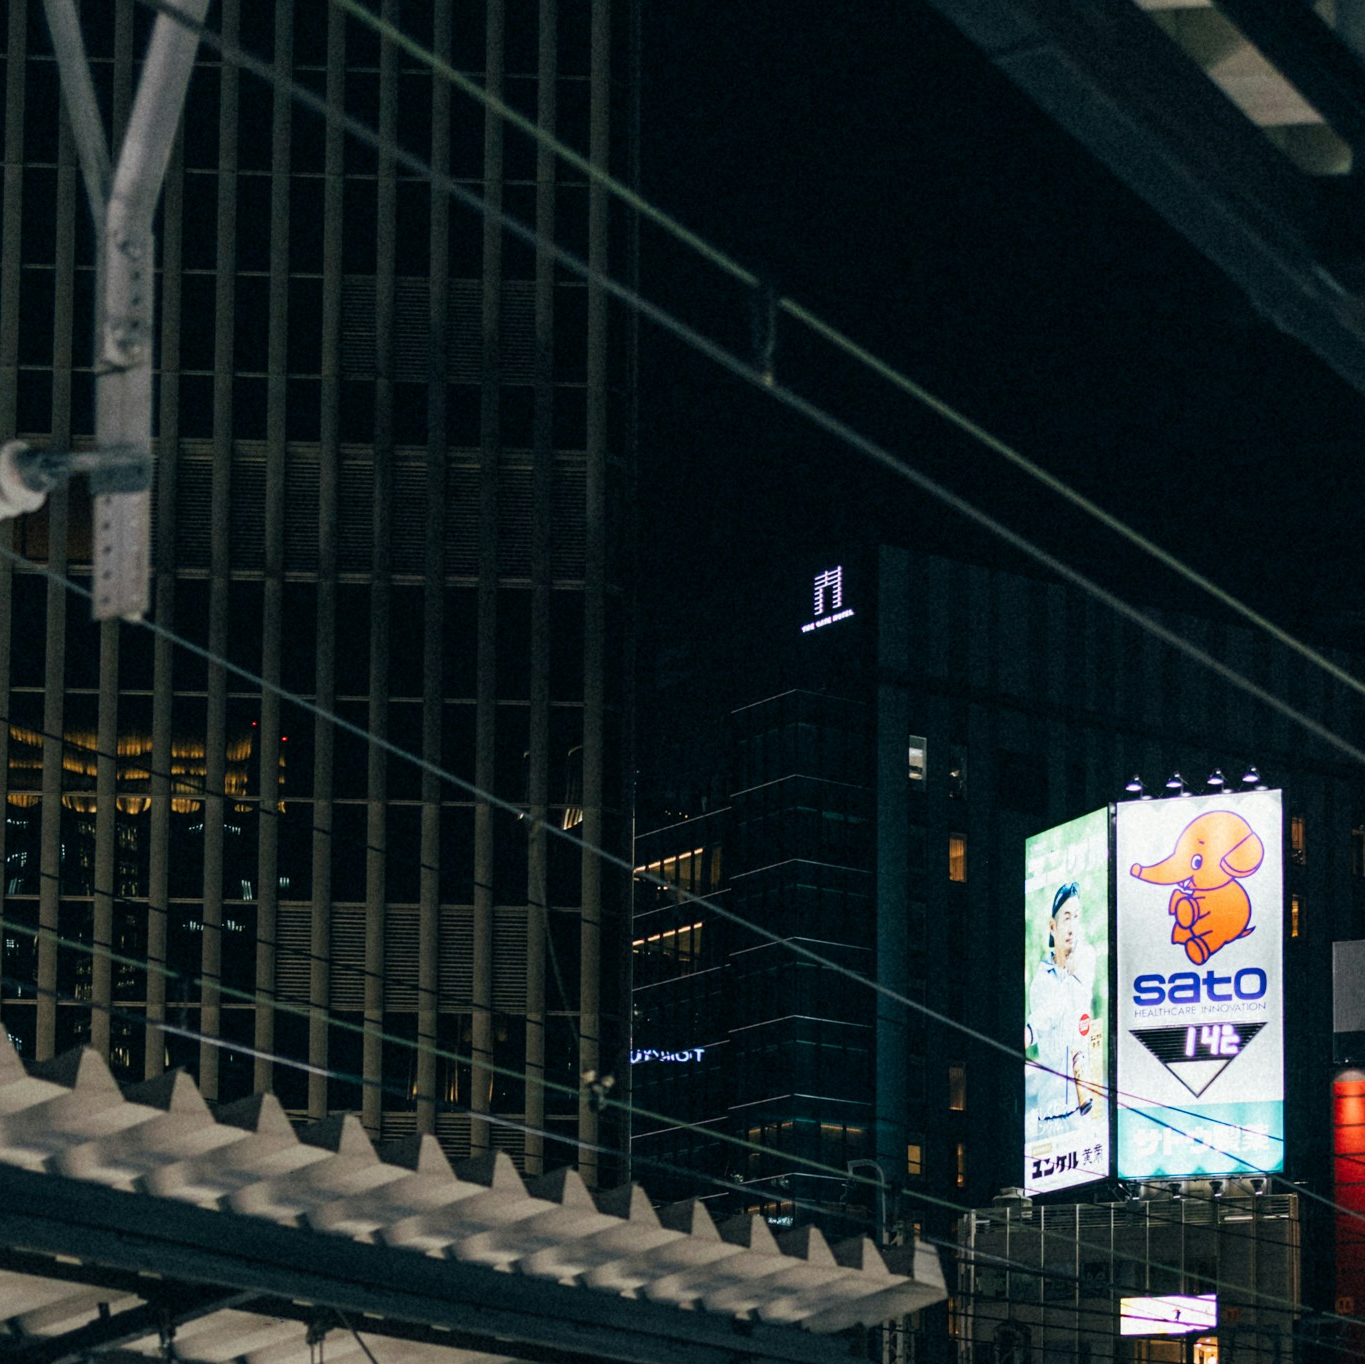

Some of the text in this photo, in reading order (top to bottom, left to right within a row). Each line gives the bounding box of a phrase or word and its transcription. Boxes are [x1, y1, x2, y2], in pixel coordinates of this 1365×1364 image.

[1133, 967, 1268, 1006] sato
[1134, 1002, 1267, 1018] HEALTHCARE INNOVATION
